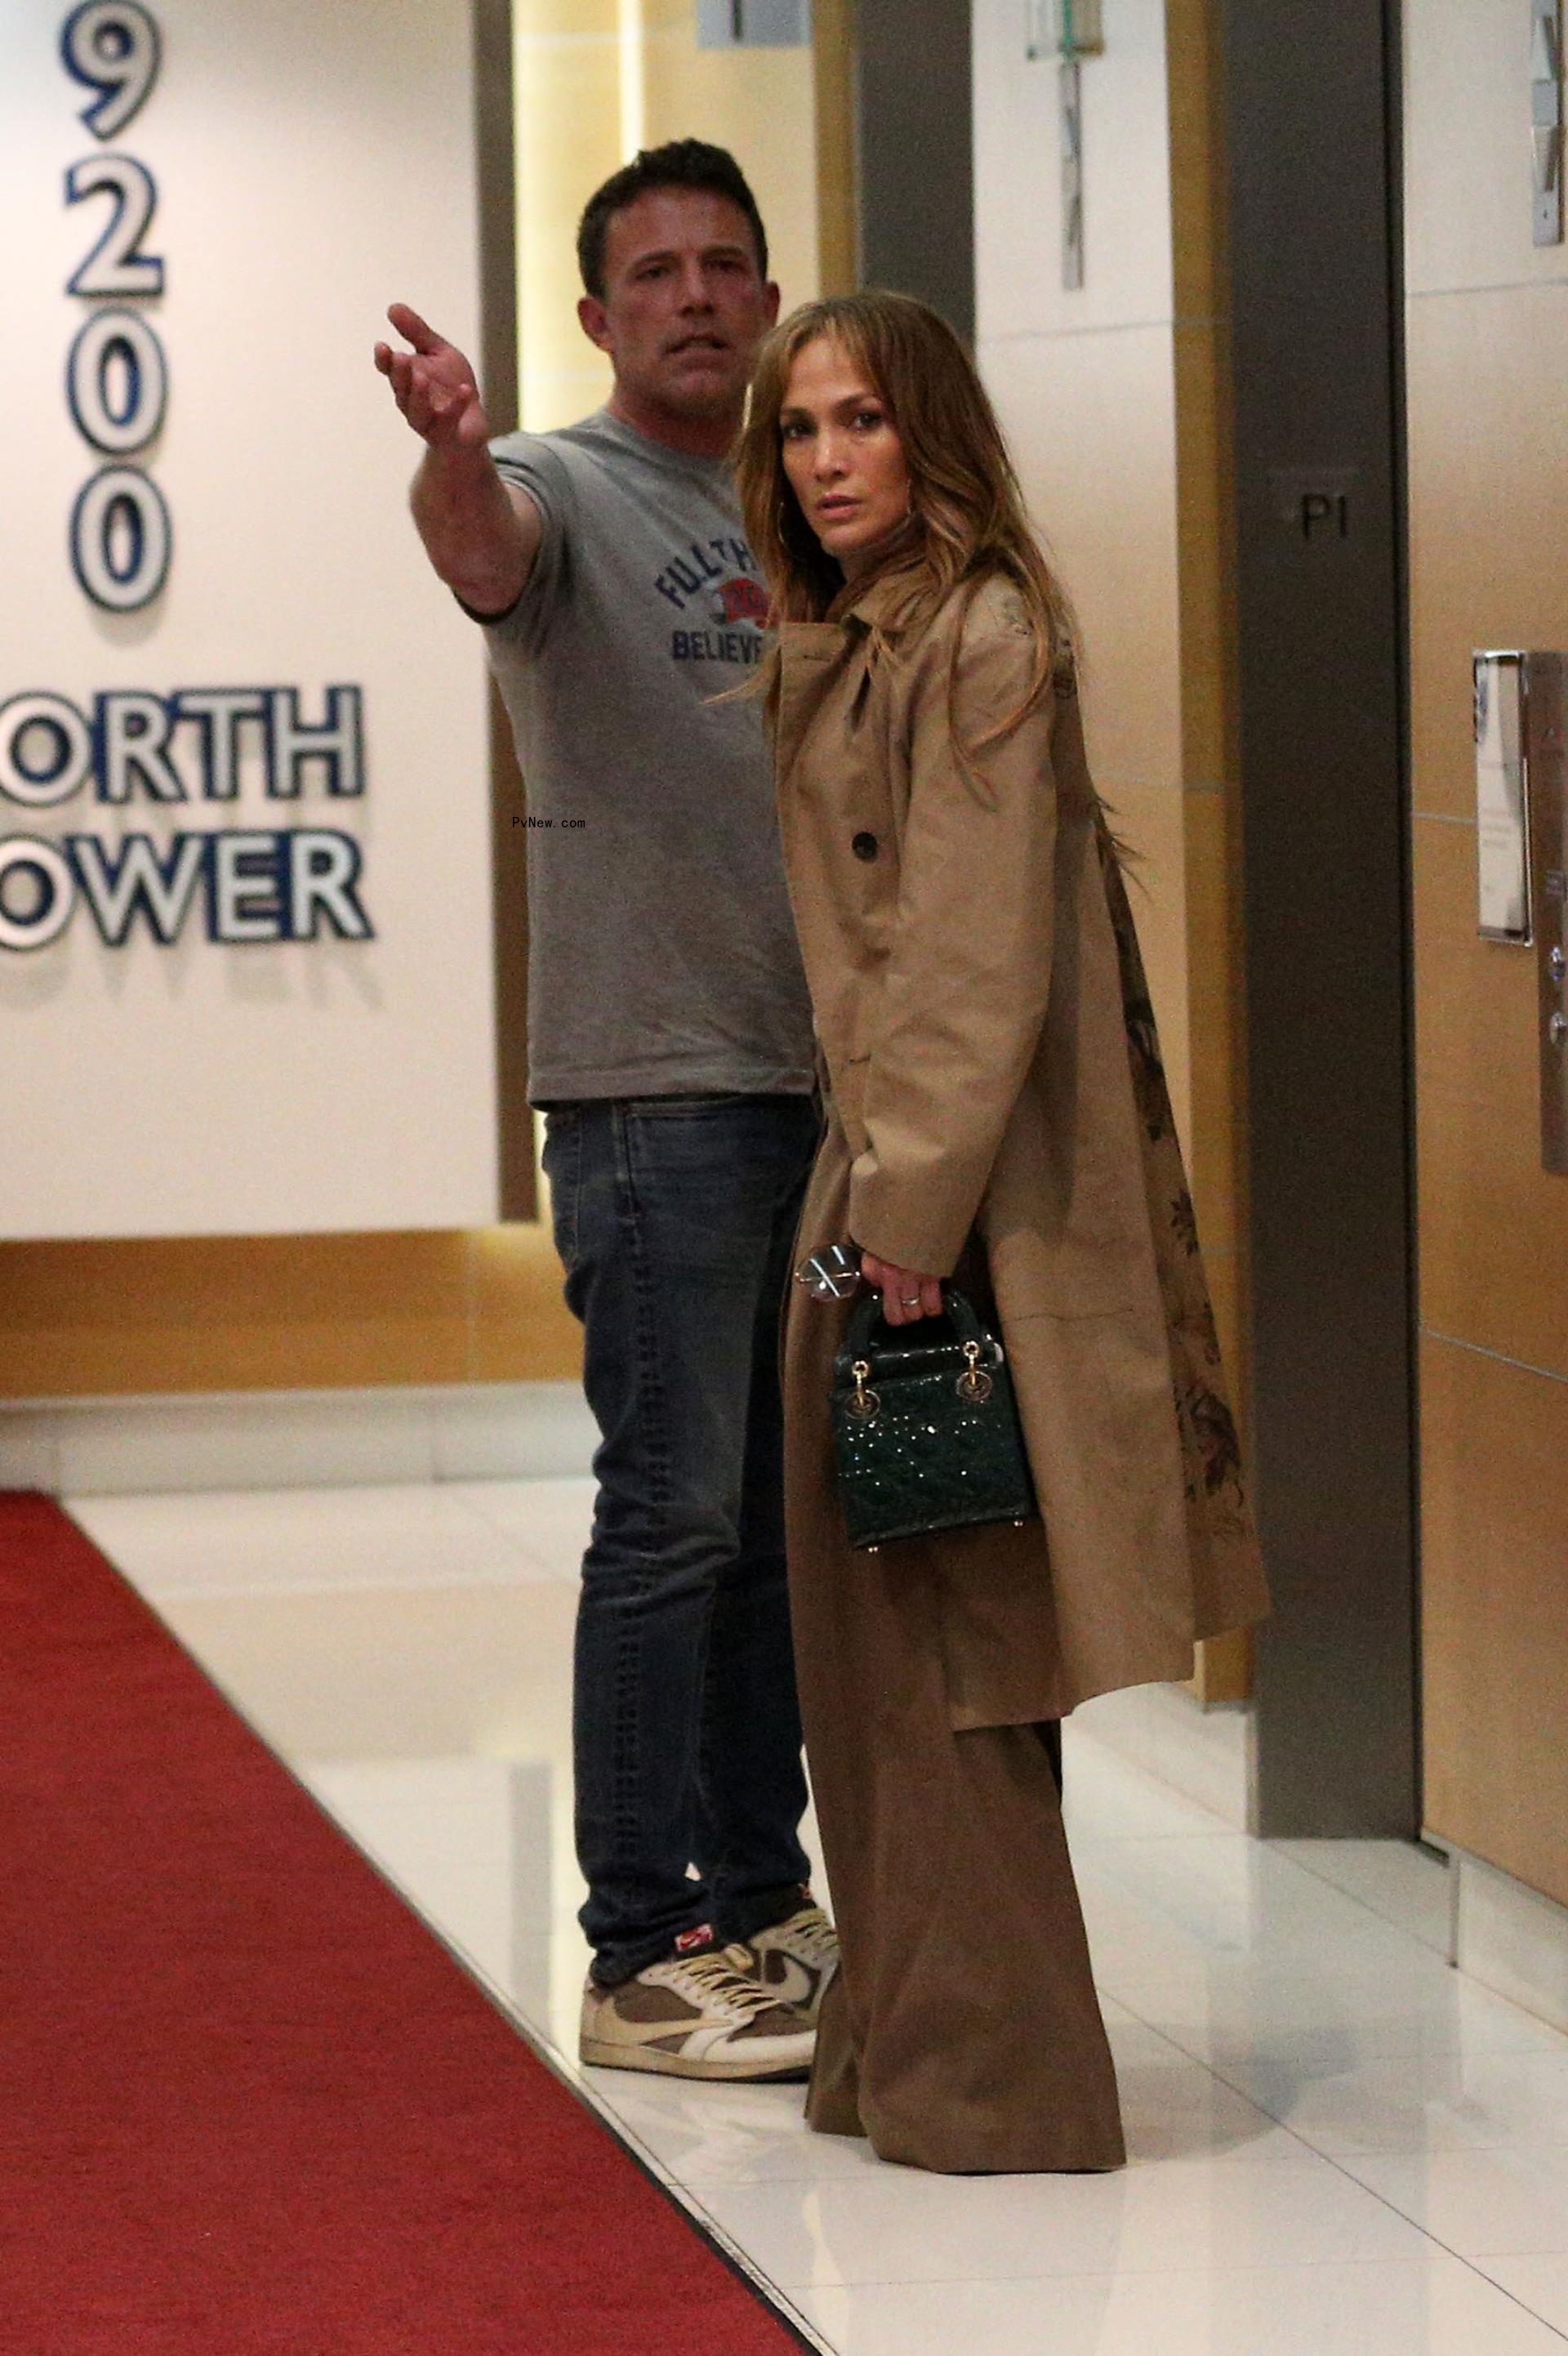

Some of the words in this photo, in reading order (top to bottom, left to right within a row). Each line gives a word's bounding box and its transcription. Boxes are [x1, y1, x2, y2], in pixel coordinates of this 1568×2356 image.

[59, 0, 172, 614] 9200
[0, 684, 365, 807] ORTH
[0, 828, 376, 953] OWER
